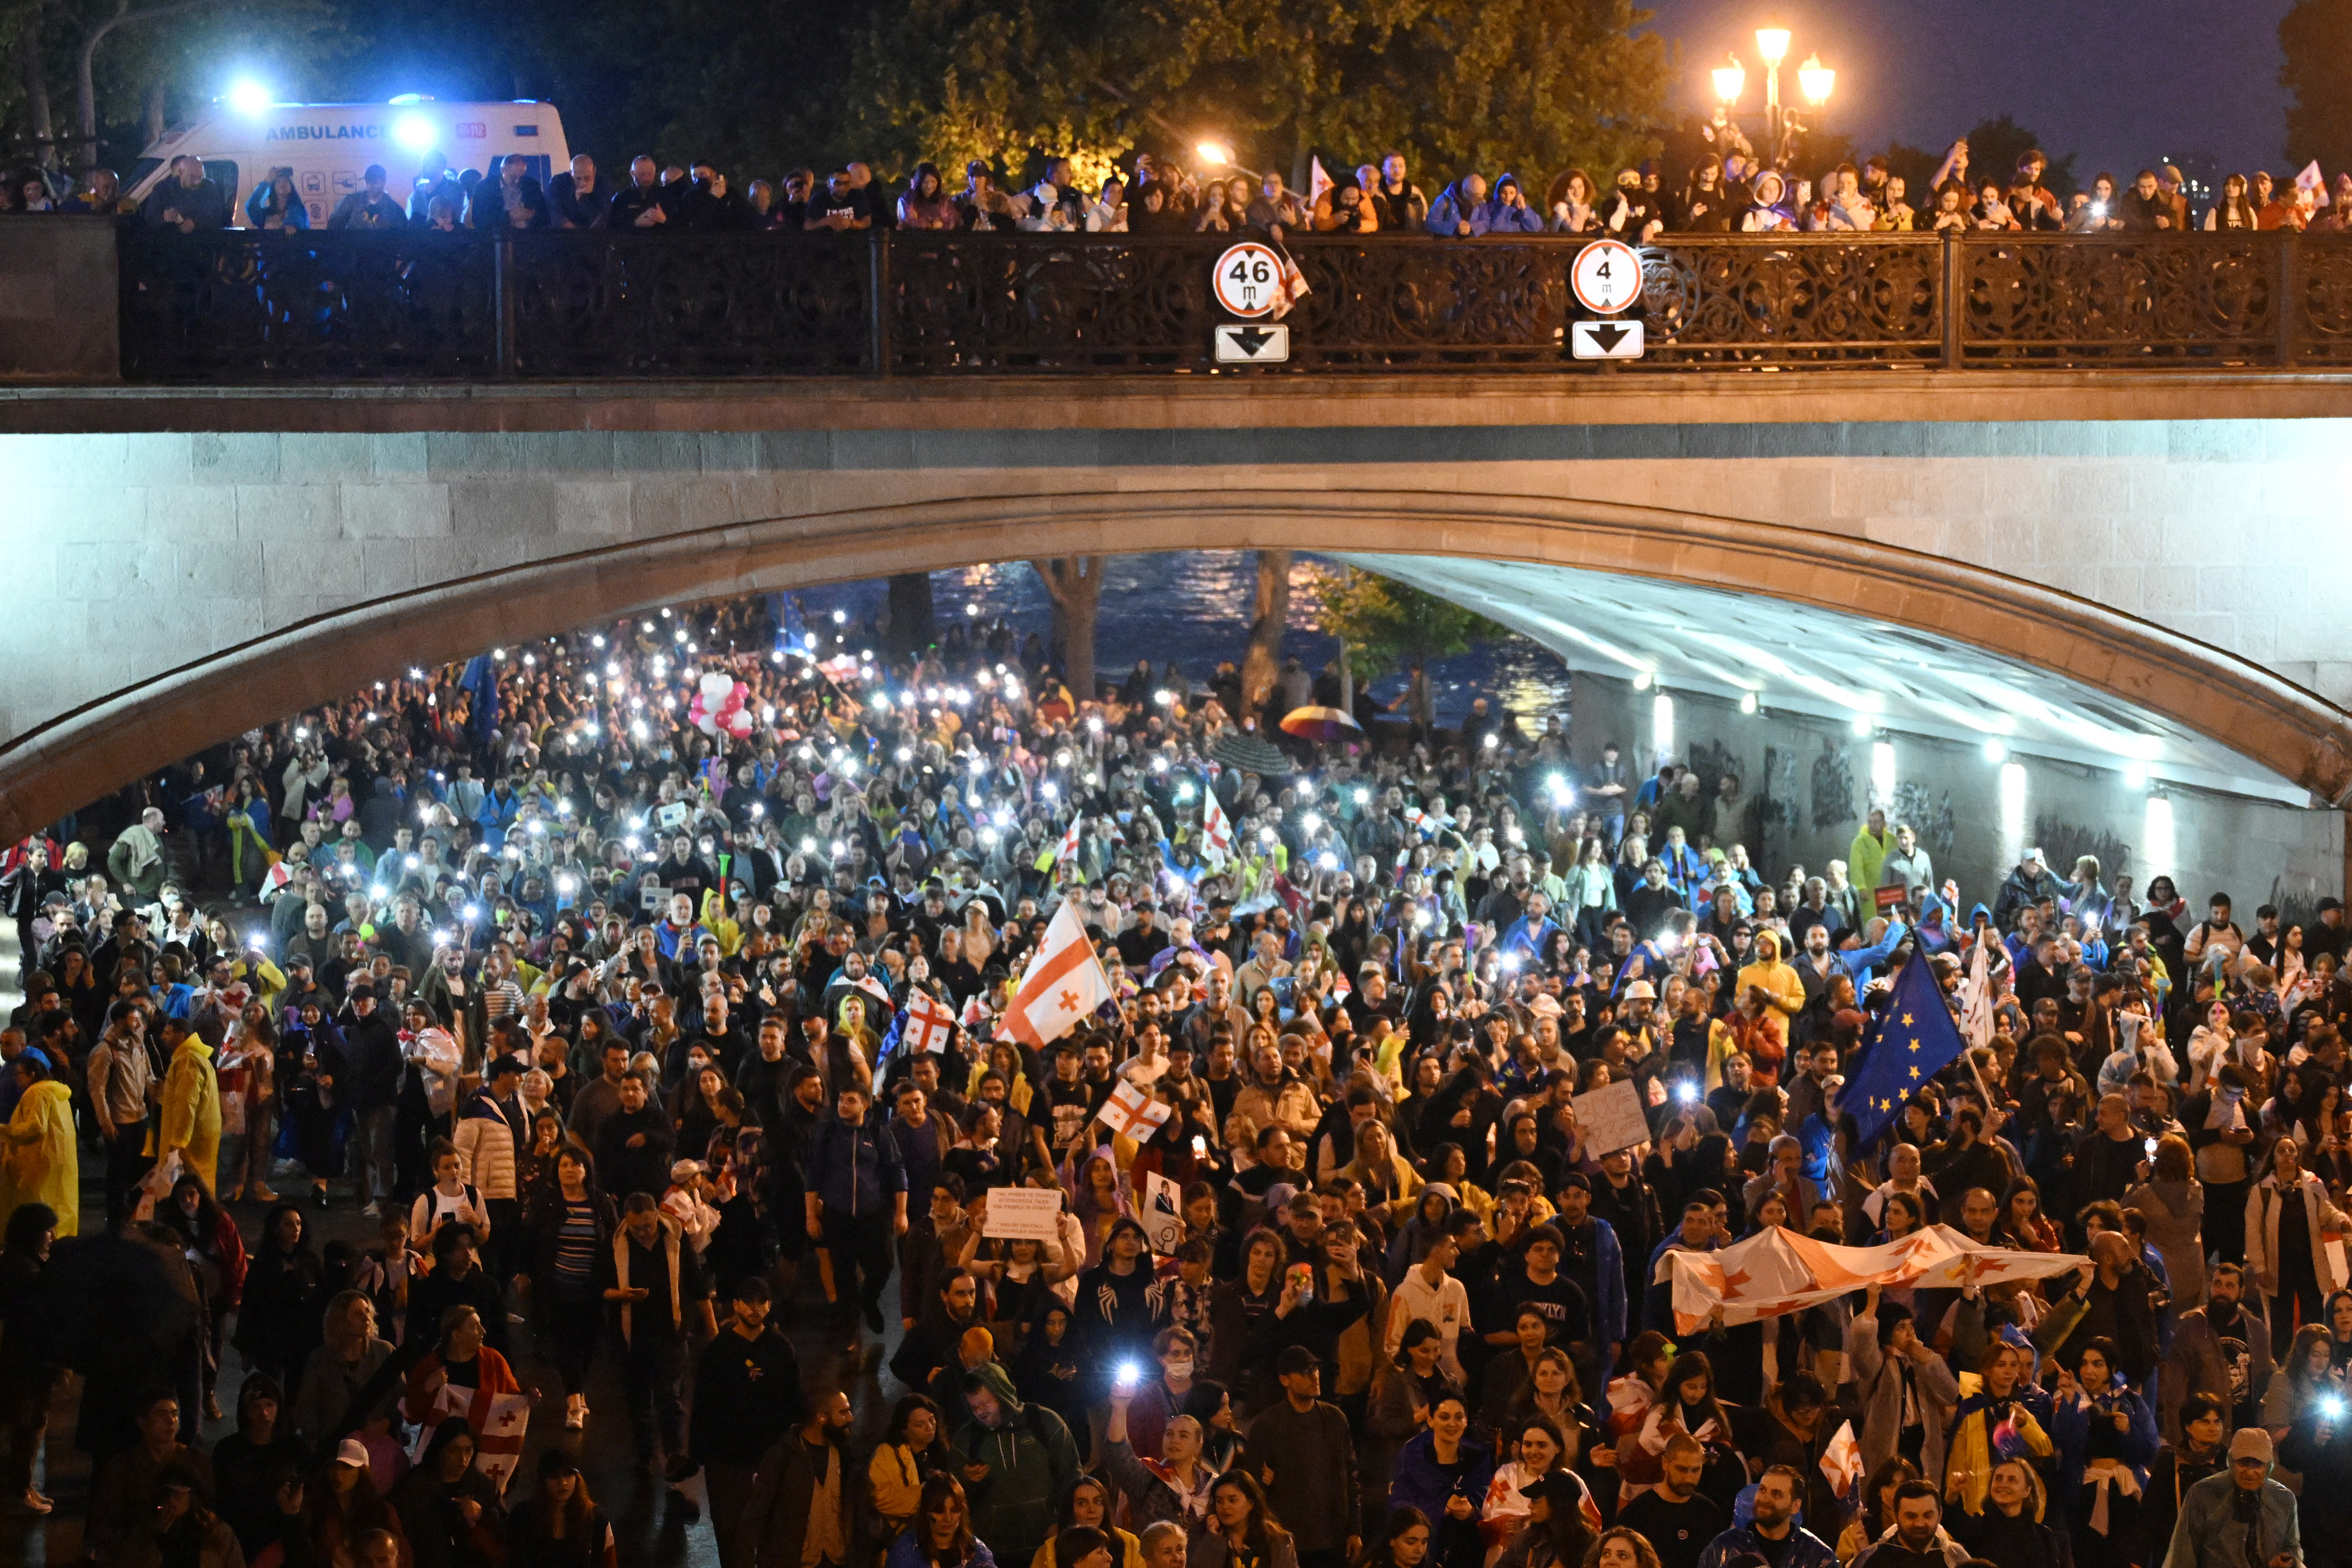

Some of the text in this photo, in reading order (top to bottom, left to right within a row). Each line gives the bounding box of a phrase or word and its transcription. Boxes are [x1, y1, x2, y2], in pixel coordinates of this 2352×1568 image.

[266, 125, 390, 141] AMBULANCE
[1597, 261, 1611, 279] 4
[1243, 286, 1256, 300] m
[1602, 284, 1611, 293] m
